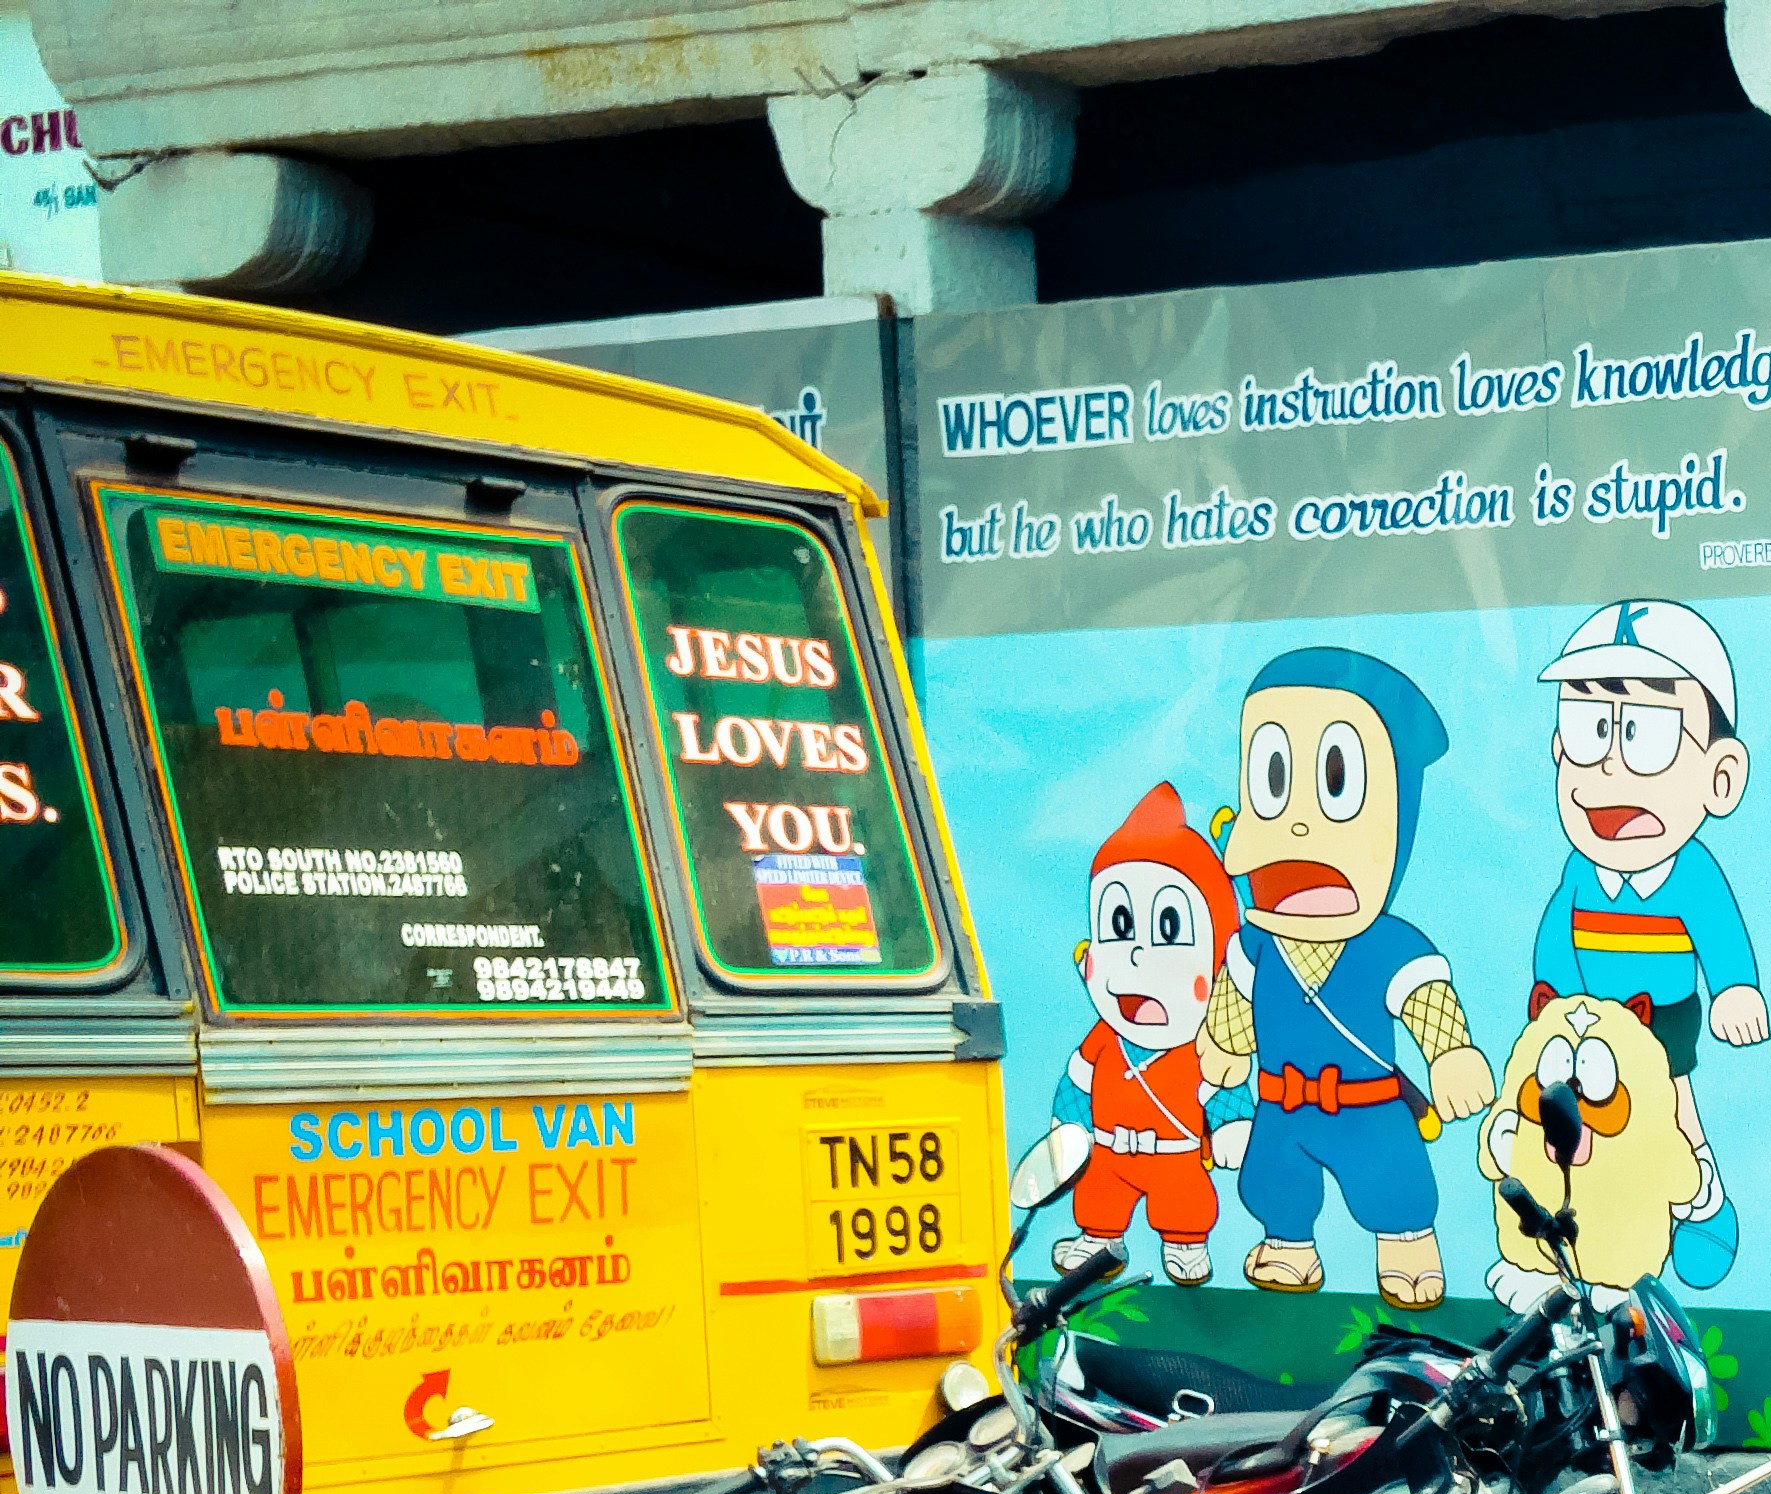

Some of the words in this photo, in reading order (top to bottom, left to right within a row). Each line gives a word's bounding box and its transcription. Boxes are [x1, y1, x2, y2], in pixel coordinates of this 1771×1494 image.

[939, 388, 1132, 454] WHOEVER
[1146, 381, 1229, 440] loves
[1243, 366, 1440, 428] instruction
[1454, 359, 1562, 413] loves
[942, 509, 1003, 560] but
[1014, 505, 1057, 556] he
[1074, 498, 1150, 554] who
[1165, 490, 1274, 546] hates
[1293, 472, 1512, 536] correction
[1537, 467, 1573, 520] is
[1586, 453, 1745, 536] stupid.
[156, 517, 427, 590] EMERGENCY
[436, 552, 528, 603] EXIT
[1612, 602, 1649, 646] K
[666, 625, 838, 689] JESUS
[671, 711, 870, 774] LOVES
[217, 846, 264, 872] RTO
[266, 846, 343, 873] SOUTH
[722, 801, 866, 856] YOU.
[223, 870, 300, 896] POLICE
[289, 1105, 519, 1161] SCHOOL
[532, 1102, 636, 1150] VAN
[253, 1166, 507, 1240] EMERGENCY
[528, 1157, 638, 1225] EXIT
[829, 1204, 944, 1264] 1998
[291, 1234, 632, 1304] பள்ளிவாகனம்
[16, 1350, 85, 1488] NO
